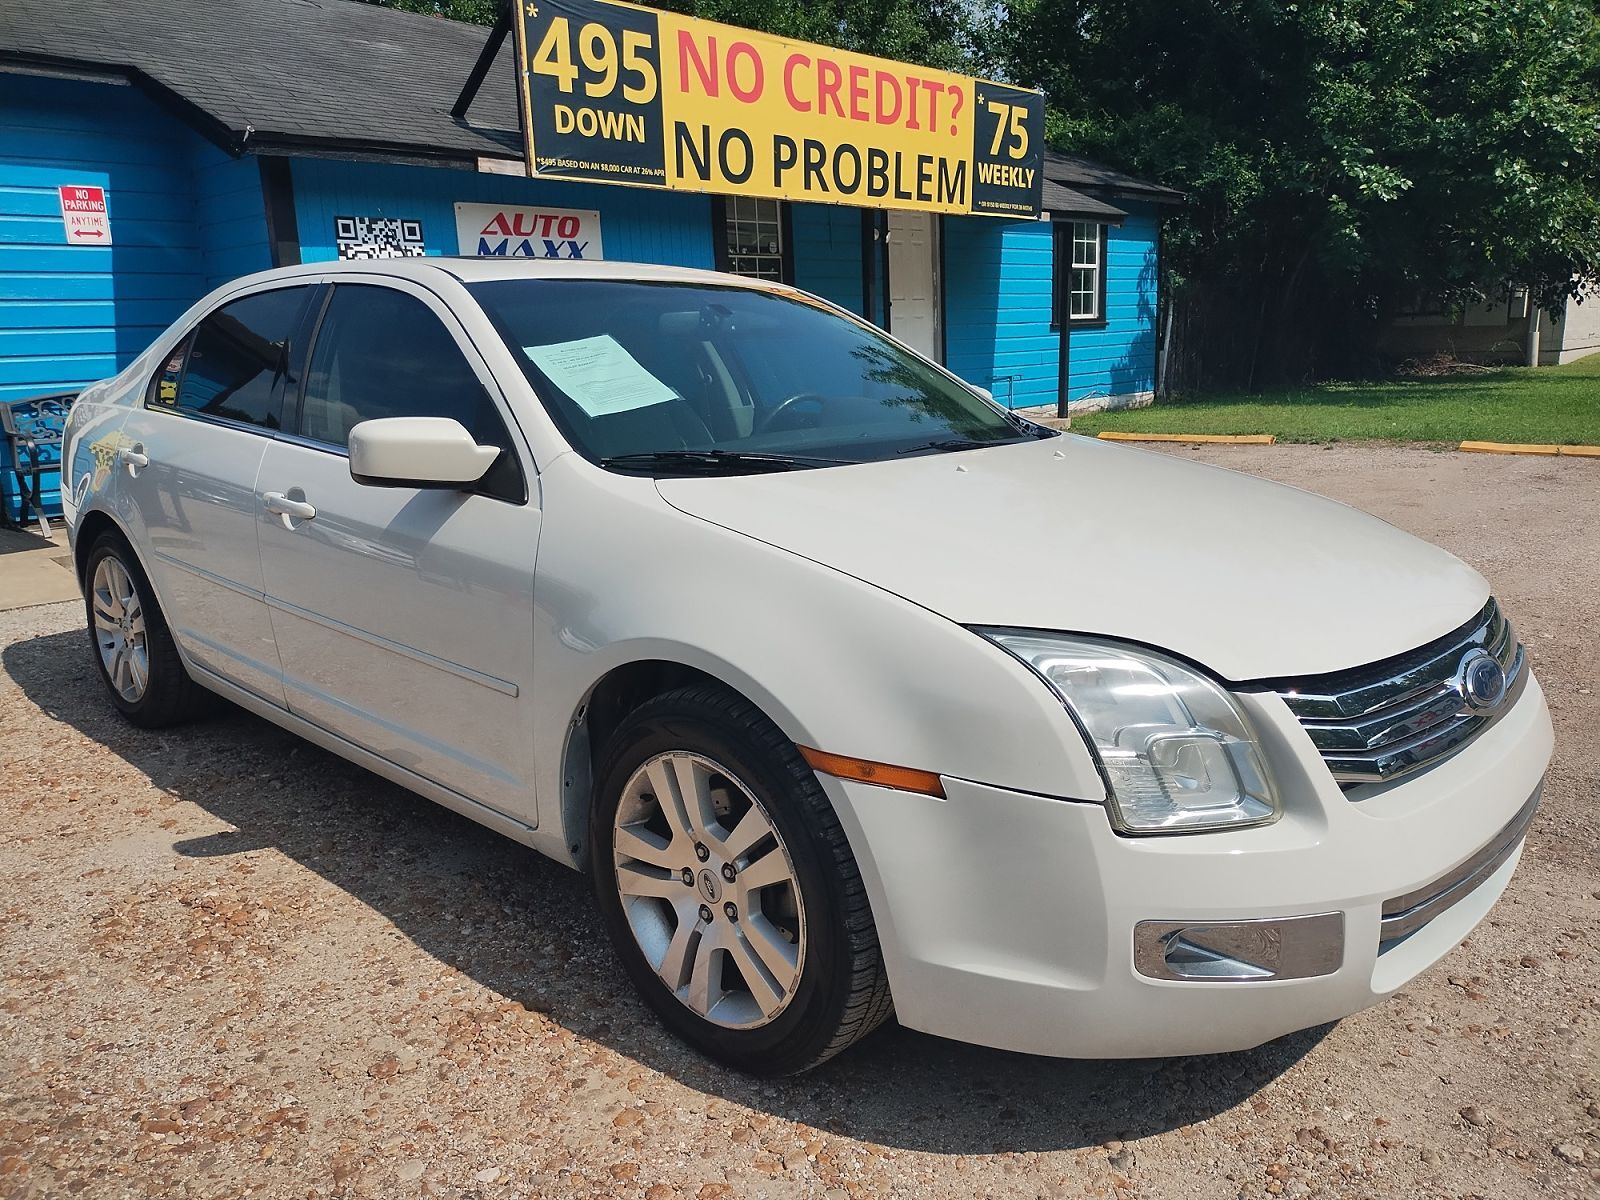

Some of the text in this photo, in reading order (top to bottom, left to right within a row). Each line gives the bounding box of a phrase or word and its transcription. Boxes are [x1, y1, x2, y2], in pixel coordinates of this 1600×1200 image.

[677, 29, 964, 137] NO CREDIT?
[554, 104, 646, 143] DOWN
[557, 159, 578, 168] BASED
[579, 161, 590, 169] ON
[590, 162, 600, 170] AN
[600, 163, 620, 172] $8,000
[620, 165, 633, 173] CAR
[632, 166, 641, 174] AT
[641, 167, 654, 176] 26%
[653, 168, 665, 177] APR
[674, 120, 967, 206] NO PROBLEM
[977, 162, 1035, 189] WEEKLY
[64, 200, 104, 211] PARKING
[75, 189, 89, 200] NO
[71, 216, 104, 226] ANYTIME
[480, 212, 580, 239] AUTO
[477, 237, 589, 259] MAXX
